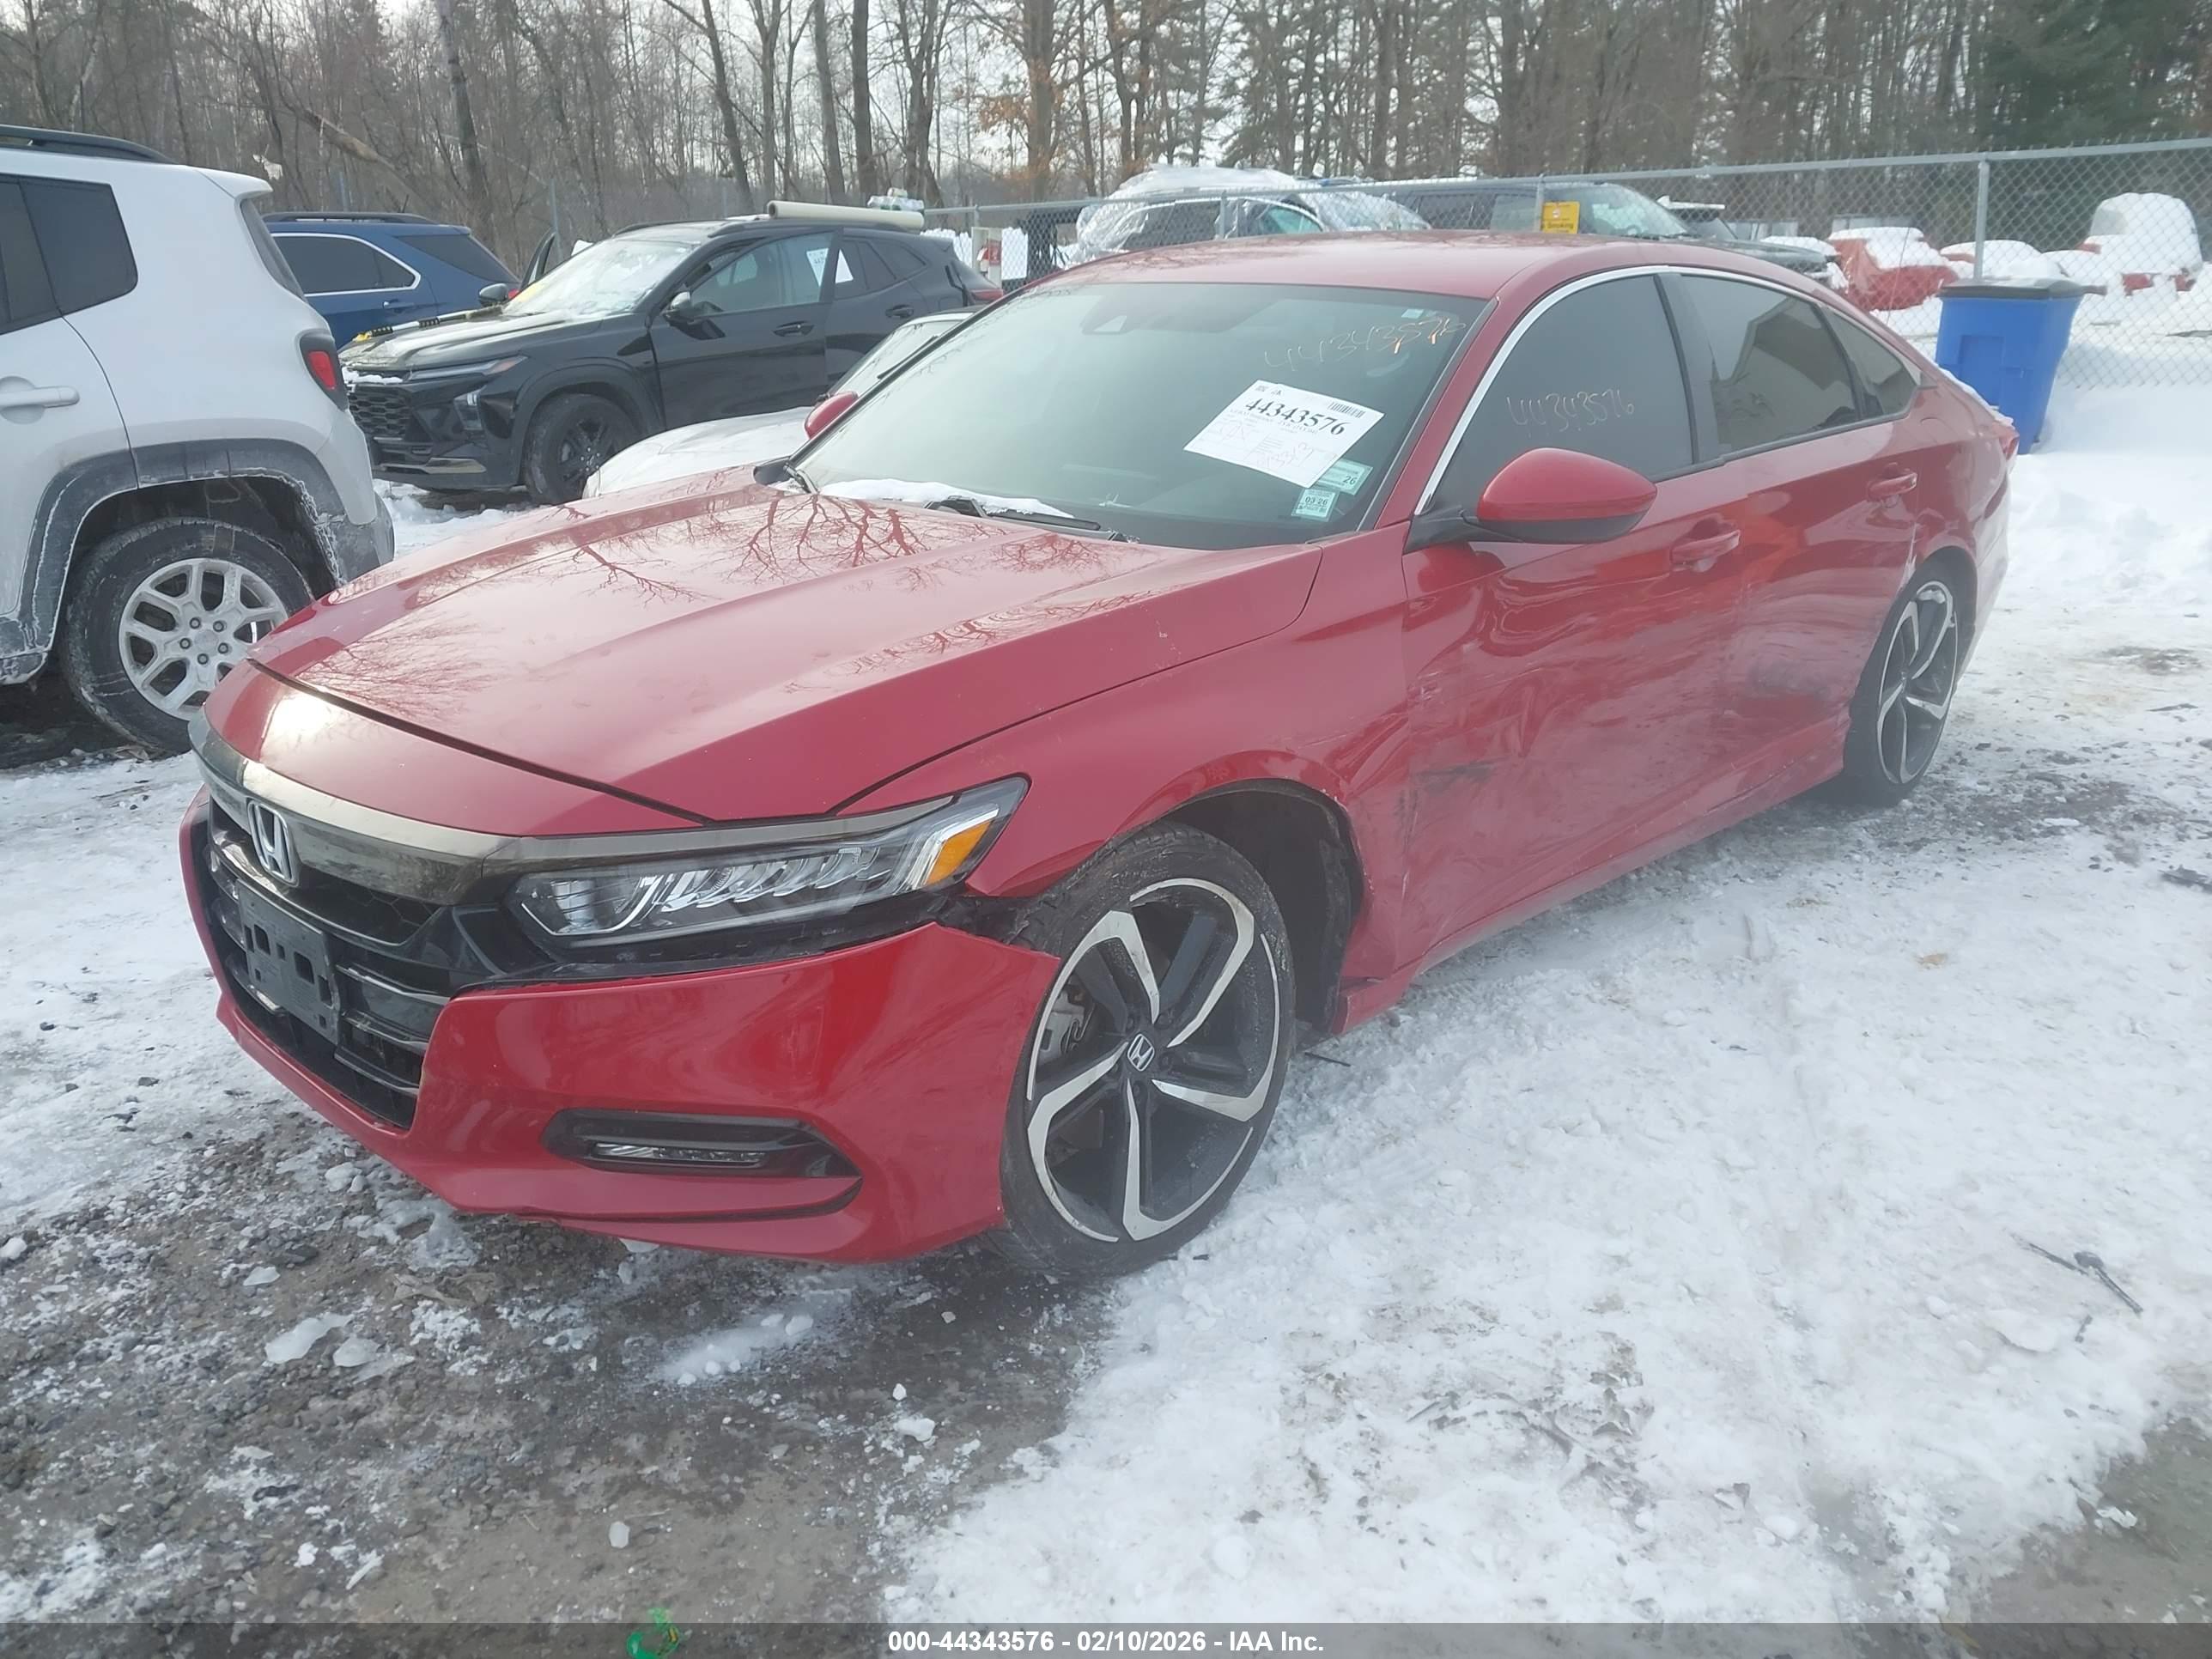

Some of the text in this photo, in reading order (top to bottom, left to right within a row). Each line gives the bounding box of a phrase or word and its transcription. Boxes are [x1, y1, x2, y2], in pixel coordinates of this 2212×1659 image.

[1264, 317, 1467, 372] 44343576
[1245, 398, 1351, 435] 44343576
[1506, 388, 1635, 433] 44343576
[1343, 475, 1358, 485] 26
